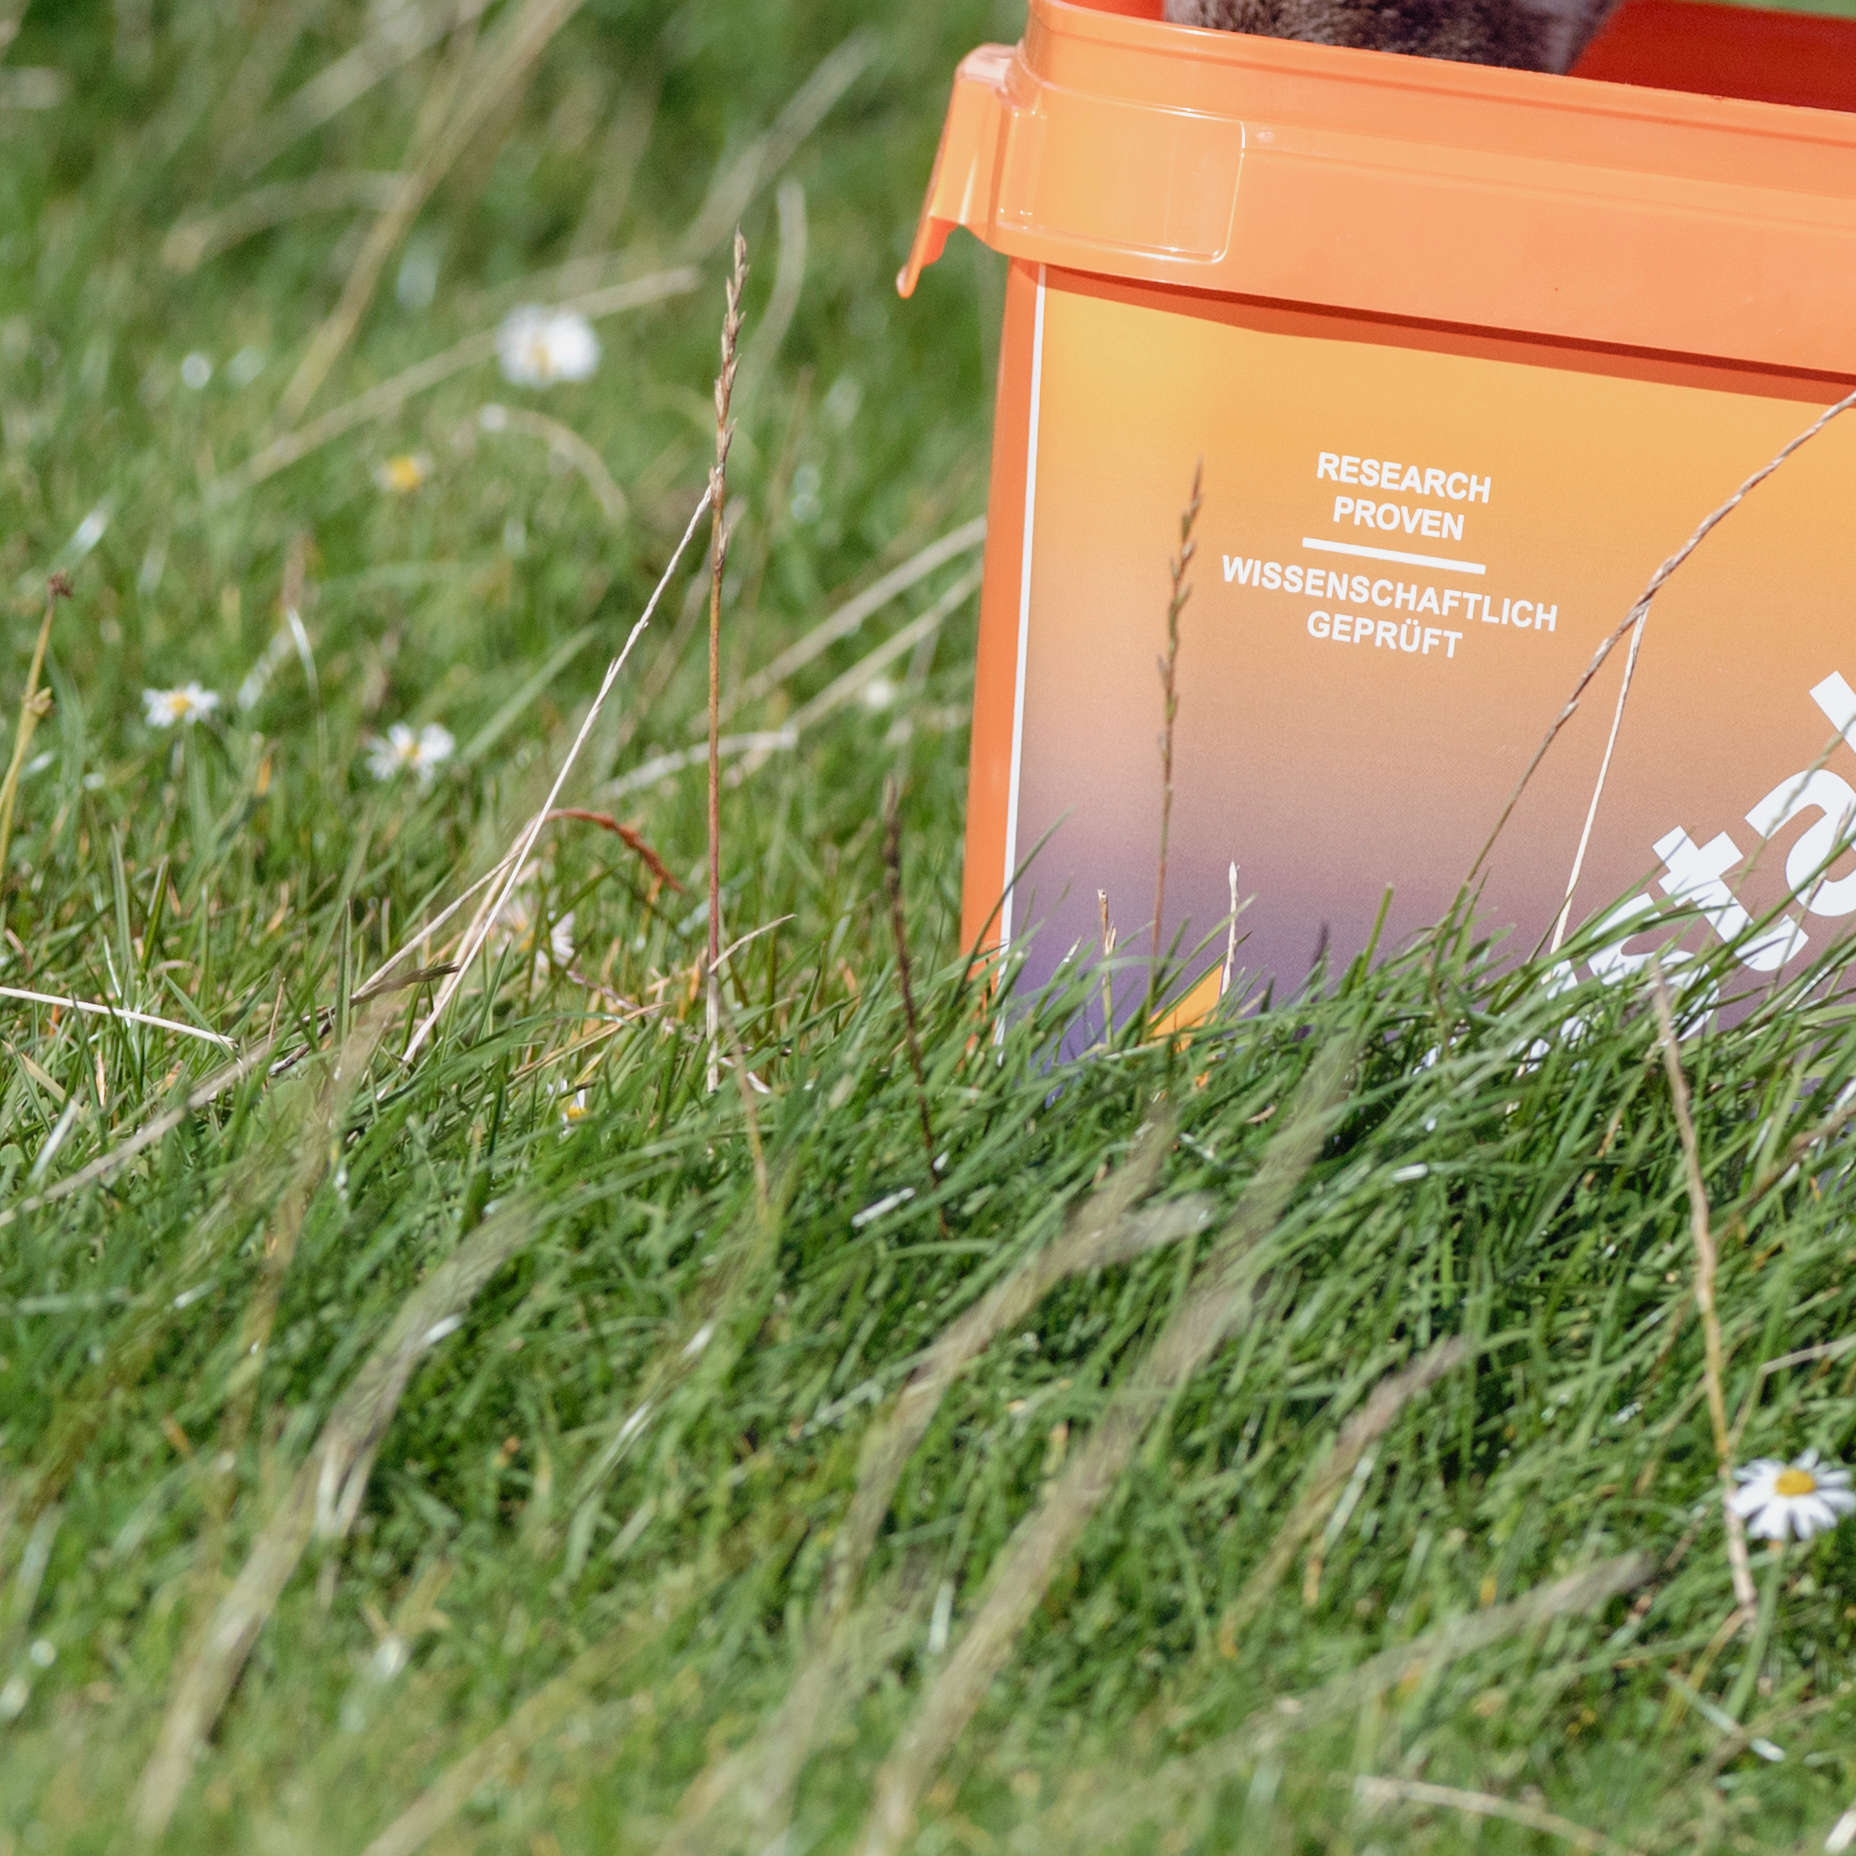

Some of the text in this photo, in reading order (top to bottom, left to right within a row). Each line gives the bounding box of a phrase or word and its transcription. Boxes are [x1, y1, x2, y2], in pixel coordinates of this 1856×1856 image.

[1316, 451, 1491, 504] RESEARCH
[1332, 495, 1464, 541] PROVEN
[1221, 554, 1558, 632] WISSENSCHAFTLICH
[1306, 610, 1463, 658] GEPRÜFT
